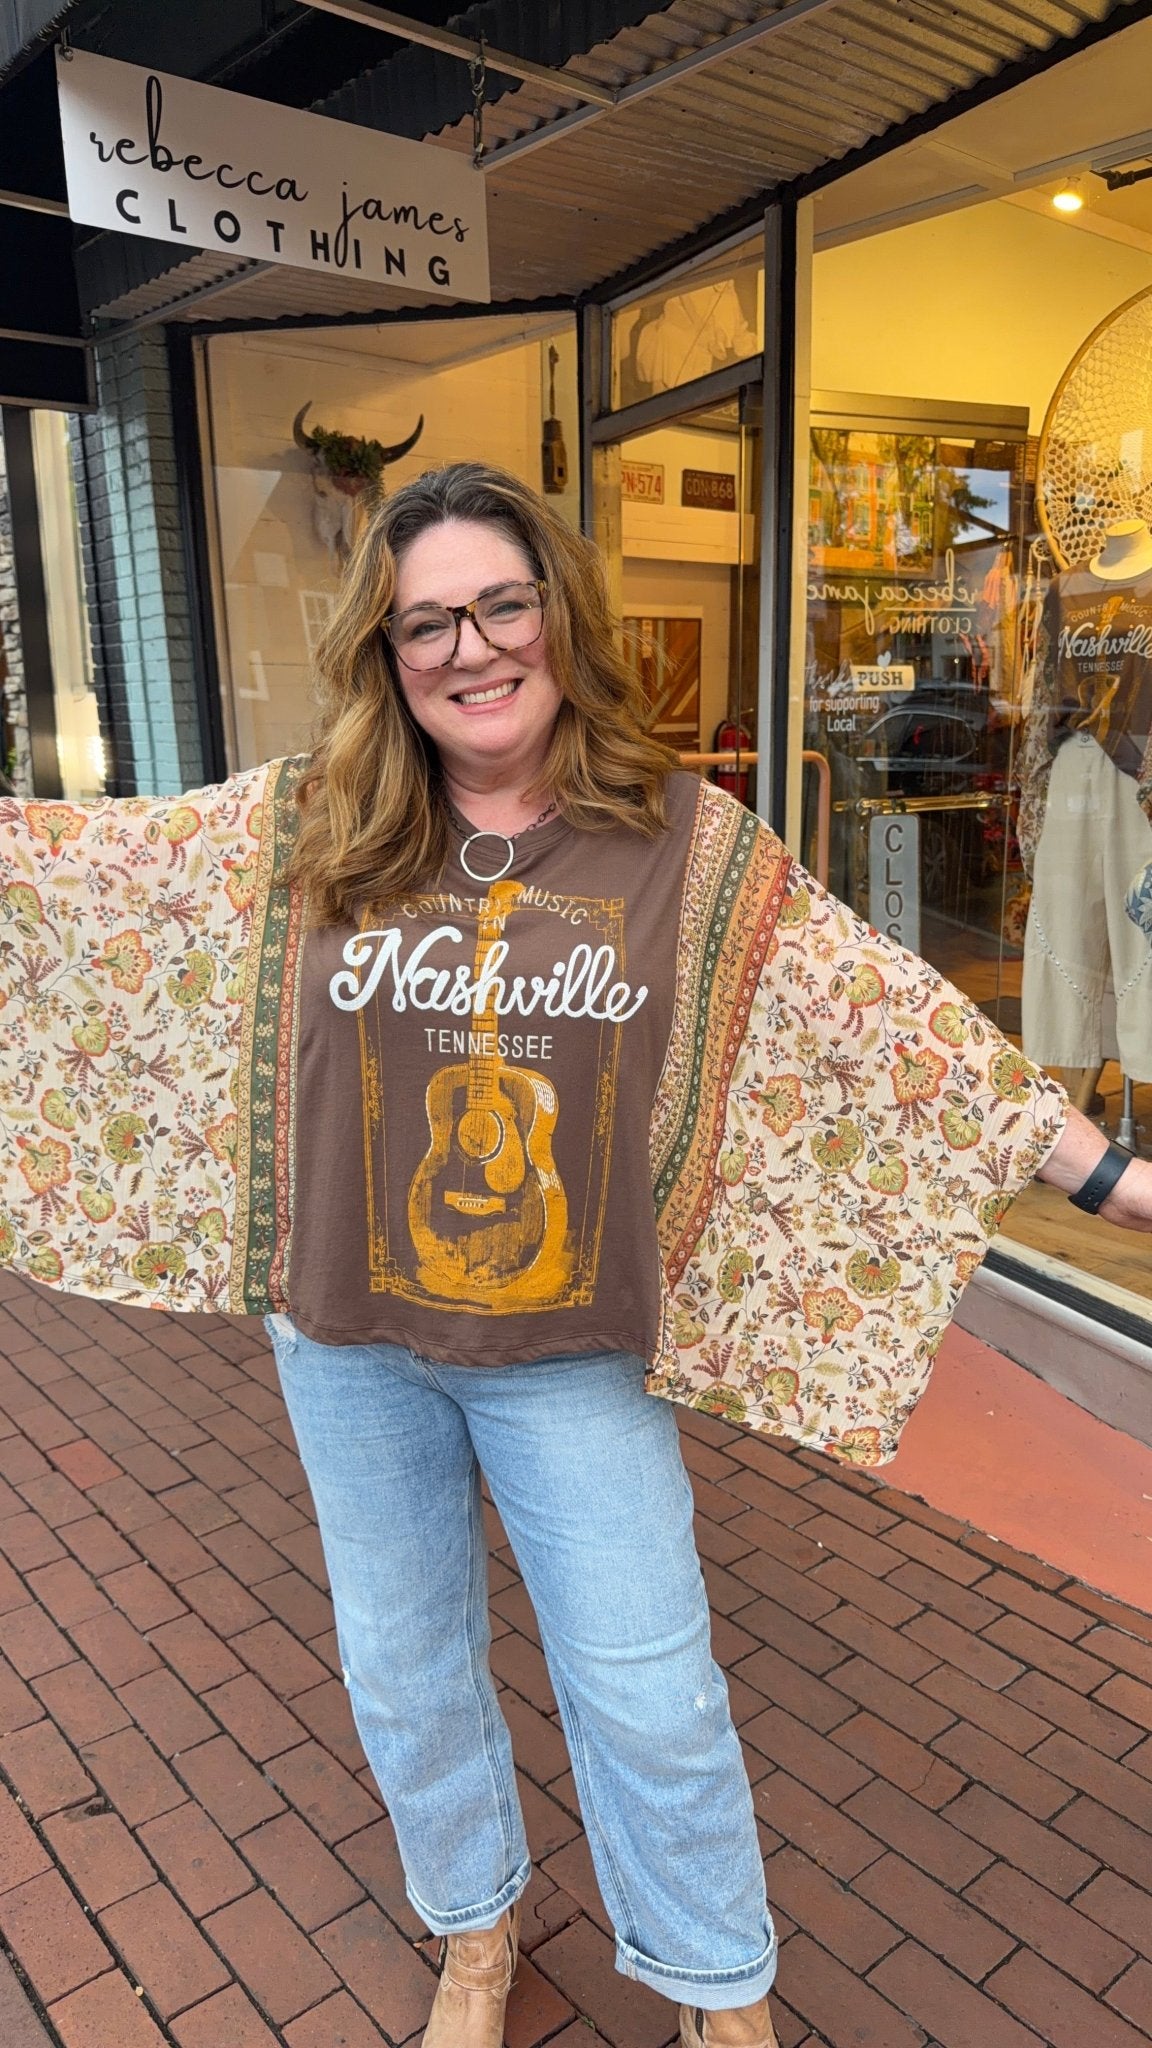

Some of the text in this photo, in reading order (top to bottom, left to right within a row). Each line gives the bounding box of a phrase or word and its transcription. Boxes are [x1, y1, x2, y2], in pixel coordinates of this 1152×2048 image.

[89, 75, 470, 269] rebecca james
[115, 188, 450, 287] CLOTHING
[857, 671, 903, 686] PUSH
[809, 692, 880, 715] for supporting
[827, 714, 857, 732] Local
[516, 884, 588, 926] MUSIC
[329, 925, 649, 1023] Nashville
[424, 1027, 553, 1060] TENNESSEE
